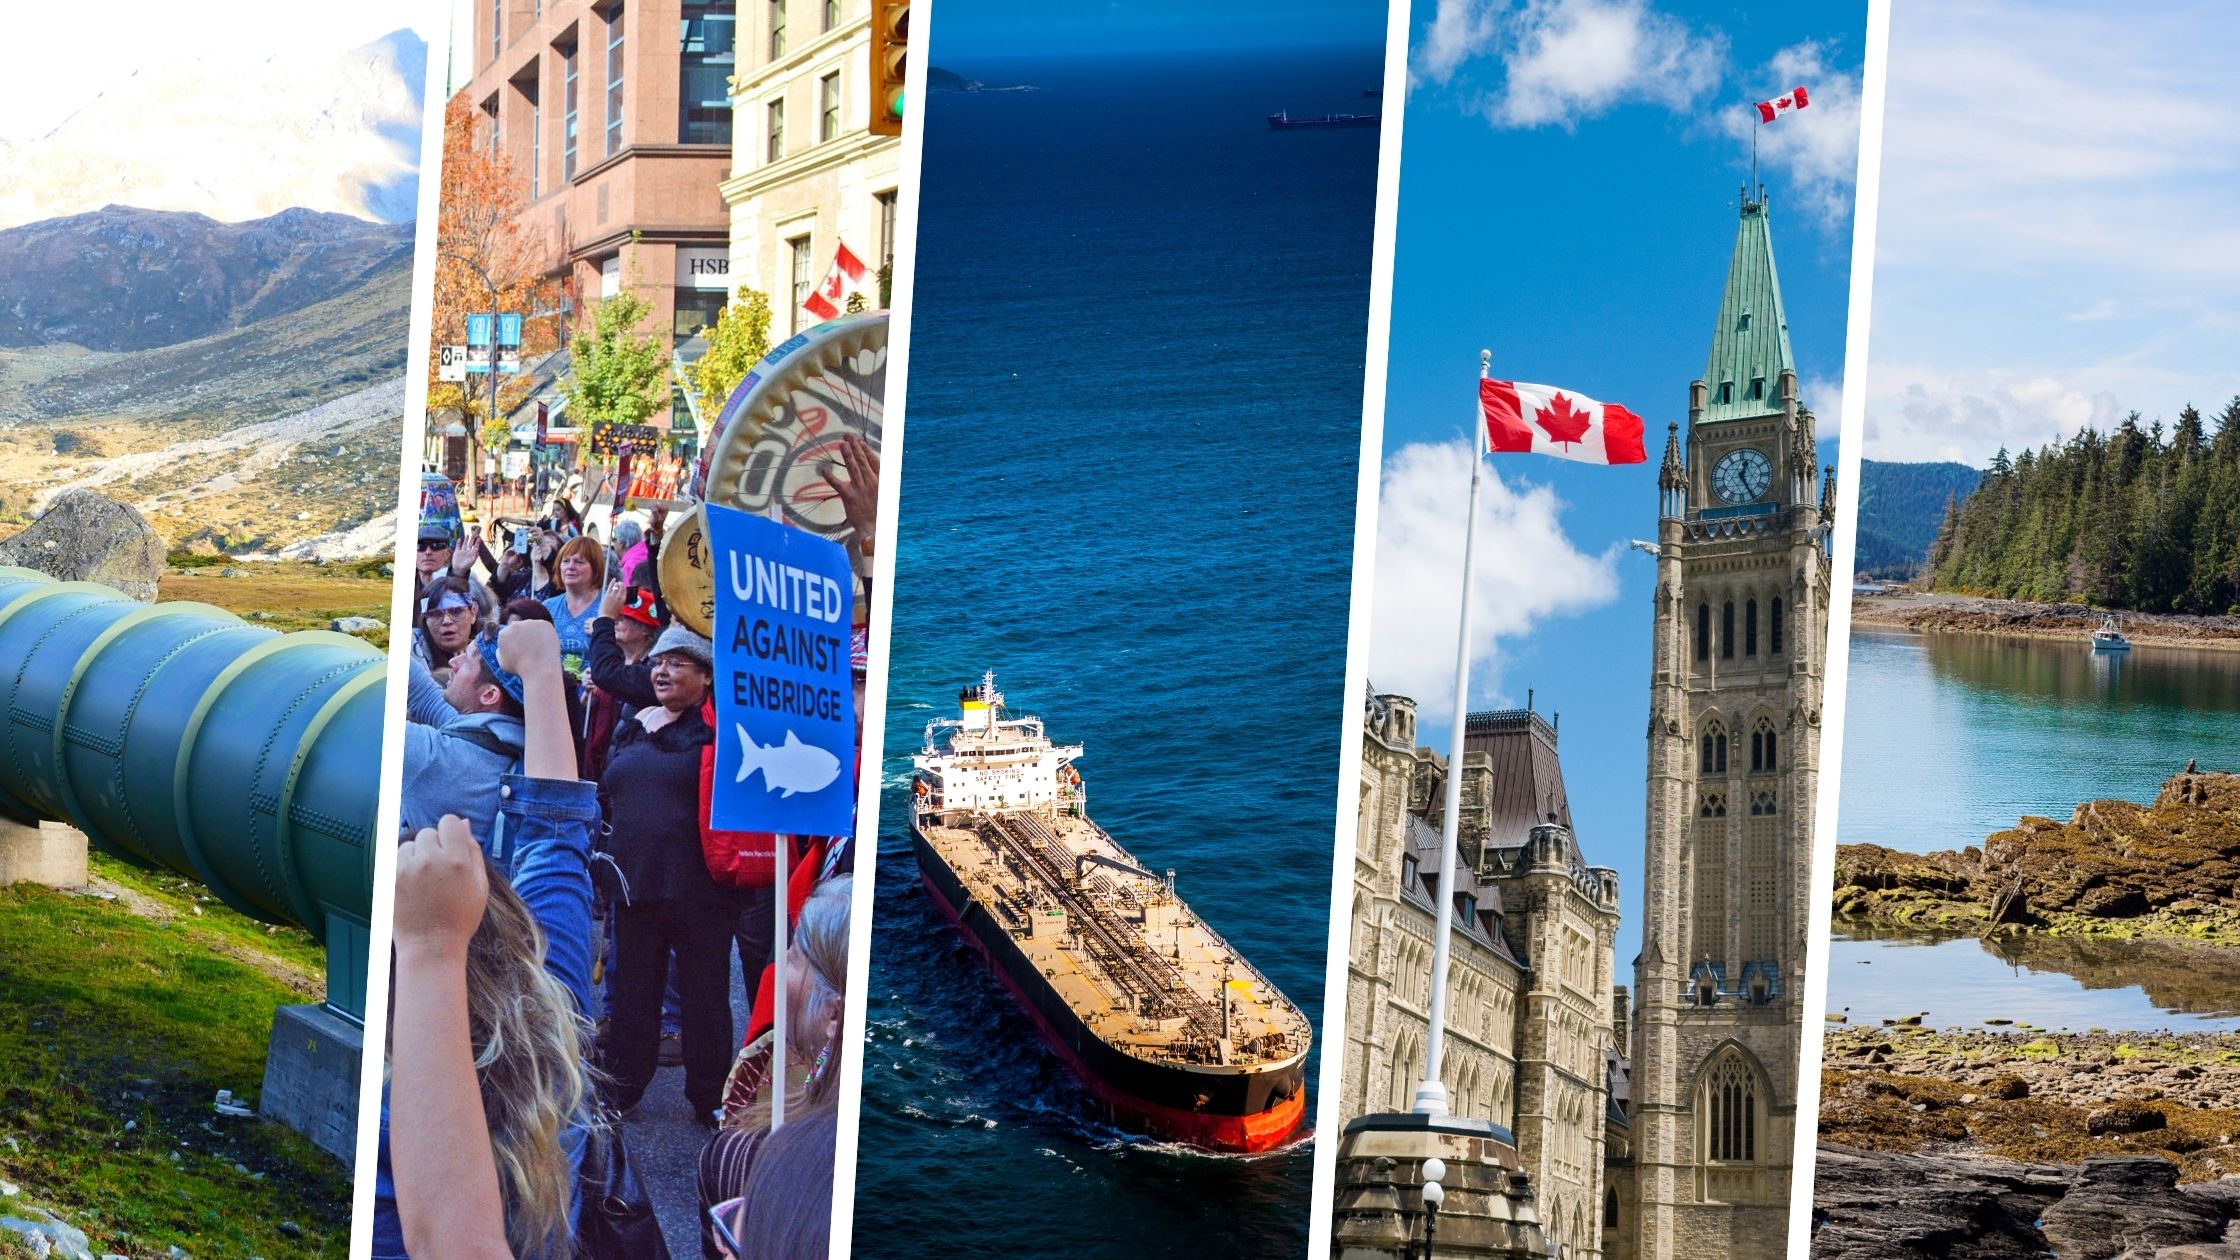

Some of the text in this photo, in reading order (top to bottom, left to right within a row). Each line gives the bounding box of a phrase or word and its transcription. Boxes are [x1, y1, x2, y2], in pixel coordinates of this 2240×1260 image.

[729, 549, 842, 624] UNITED
[731, 615, 841, 676] AGAINST
[733, 671, 842, 722] ENBRIDGE
